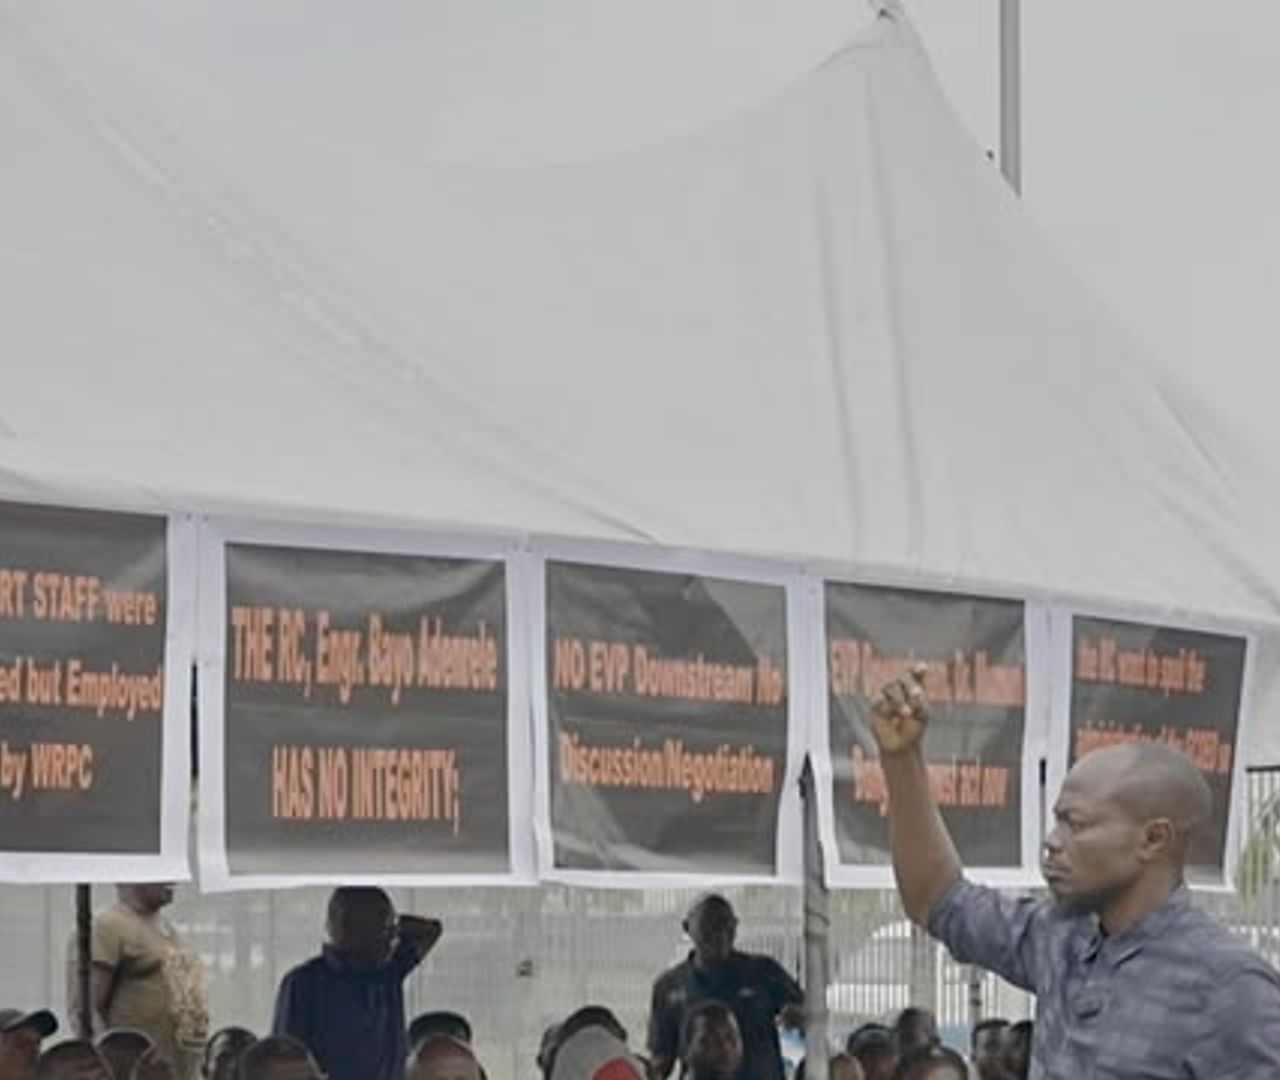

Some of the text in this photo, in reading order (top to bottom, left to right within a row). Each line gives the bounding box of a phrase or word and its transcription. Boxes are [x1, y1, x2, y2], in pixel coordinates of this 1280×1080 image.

[33, 574, 98, 621] STAFF
[106, 588, 156, 625] were
[232, 606, 273, 682] THE
[554, 638, 585, 688] NO
[591, 643, 630, 692] EVP
[28, 658, 61, 706] but
[67, 659, 163, 721] Employed
[2, 742, 25, 799] by
[31, 743, 92, 790] WRPC
[273, 745, 315, 819] HAS
[320, 746, 349, 819] NO
